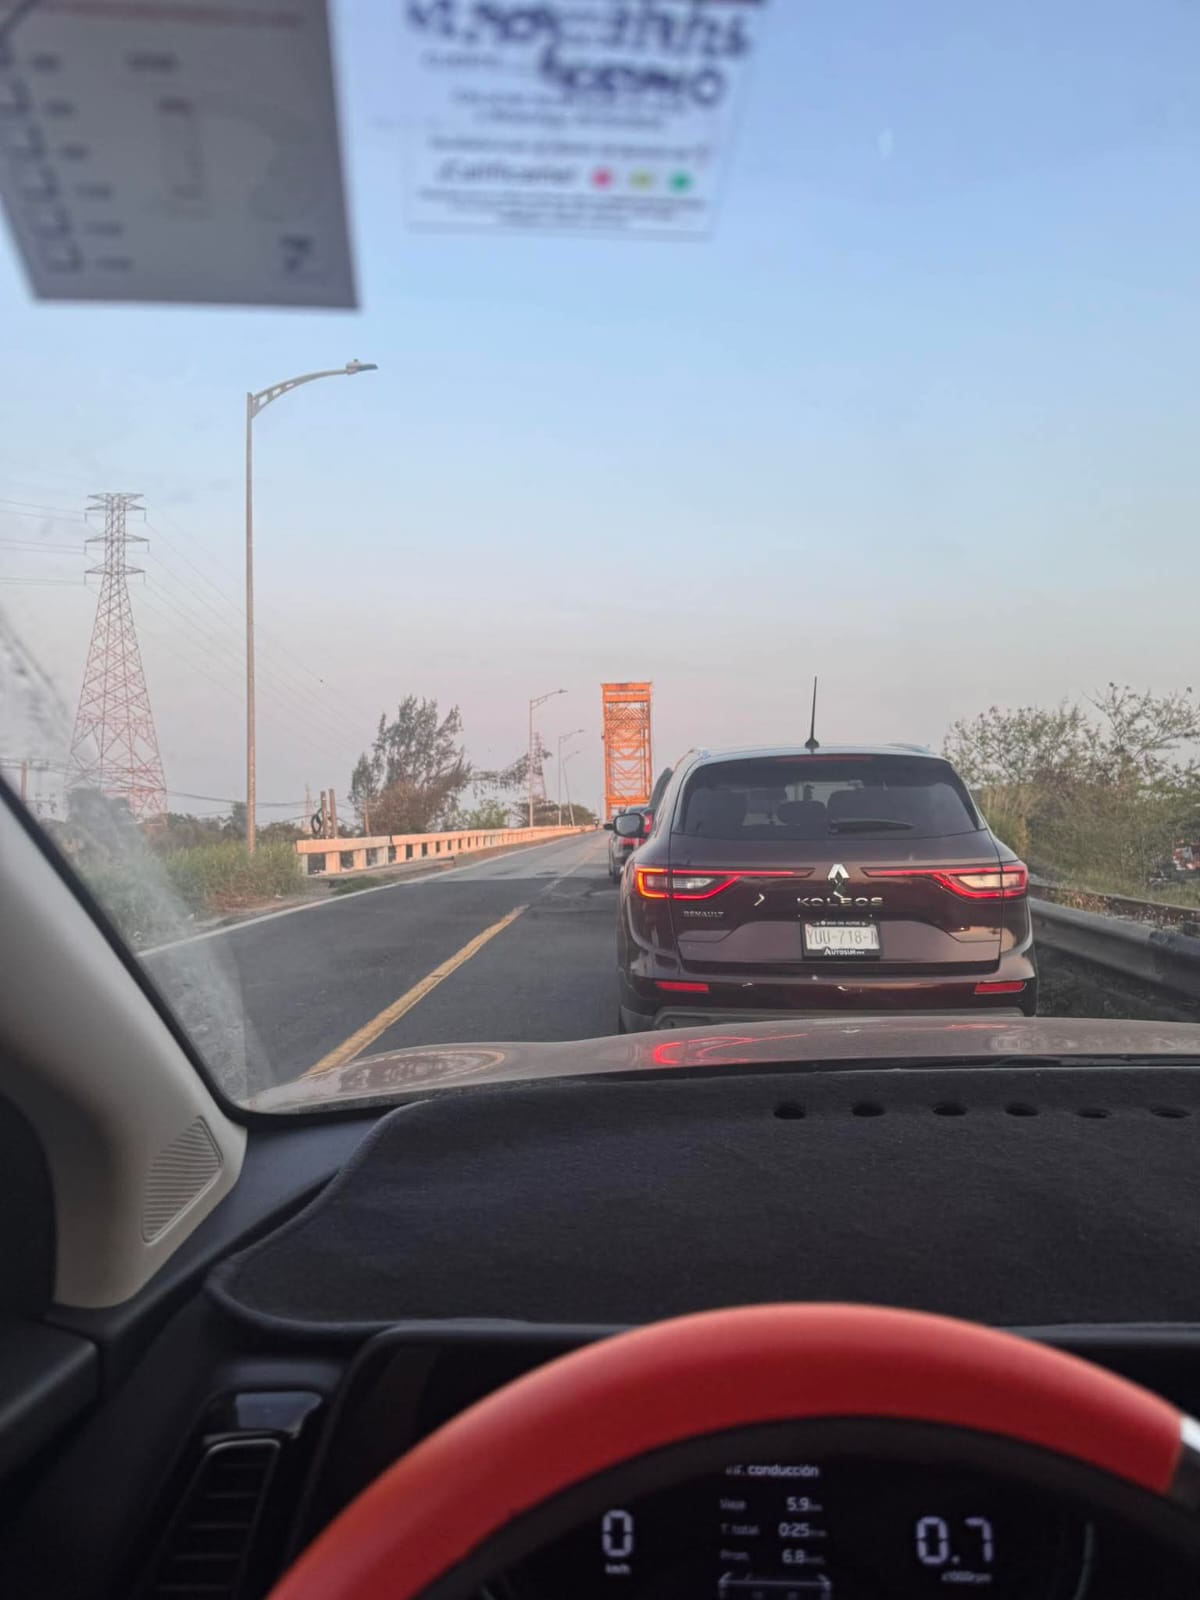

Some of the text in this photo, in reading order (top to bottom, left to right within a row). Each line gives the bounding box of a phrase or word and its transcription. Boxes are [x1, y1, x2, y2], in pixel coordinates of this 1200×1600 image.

[797, 897, 883, 907] KOLEOS
[683, 910, 724, 918] RENAULT
[747, 1464, 820, 1477] conducción
[602, 1509, 633, 1557] 0
[917, 1516, 992, 1565] 0.7
